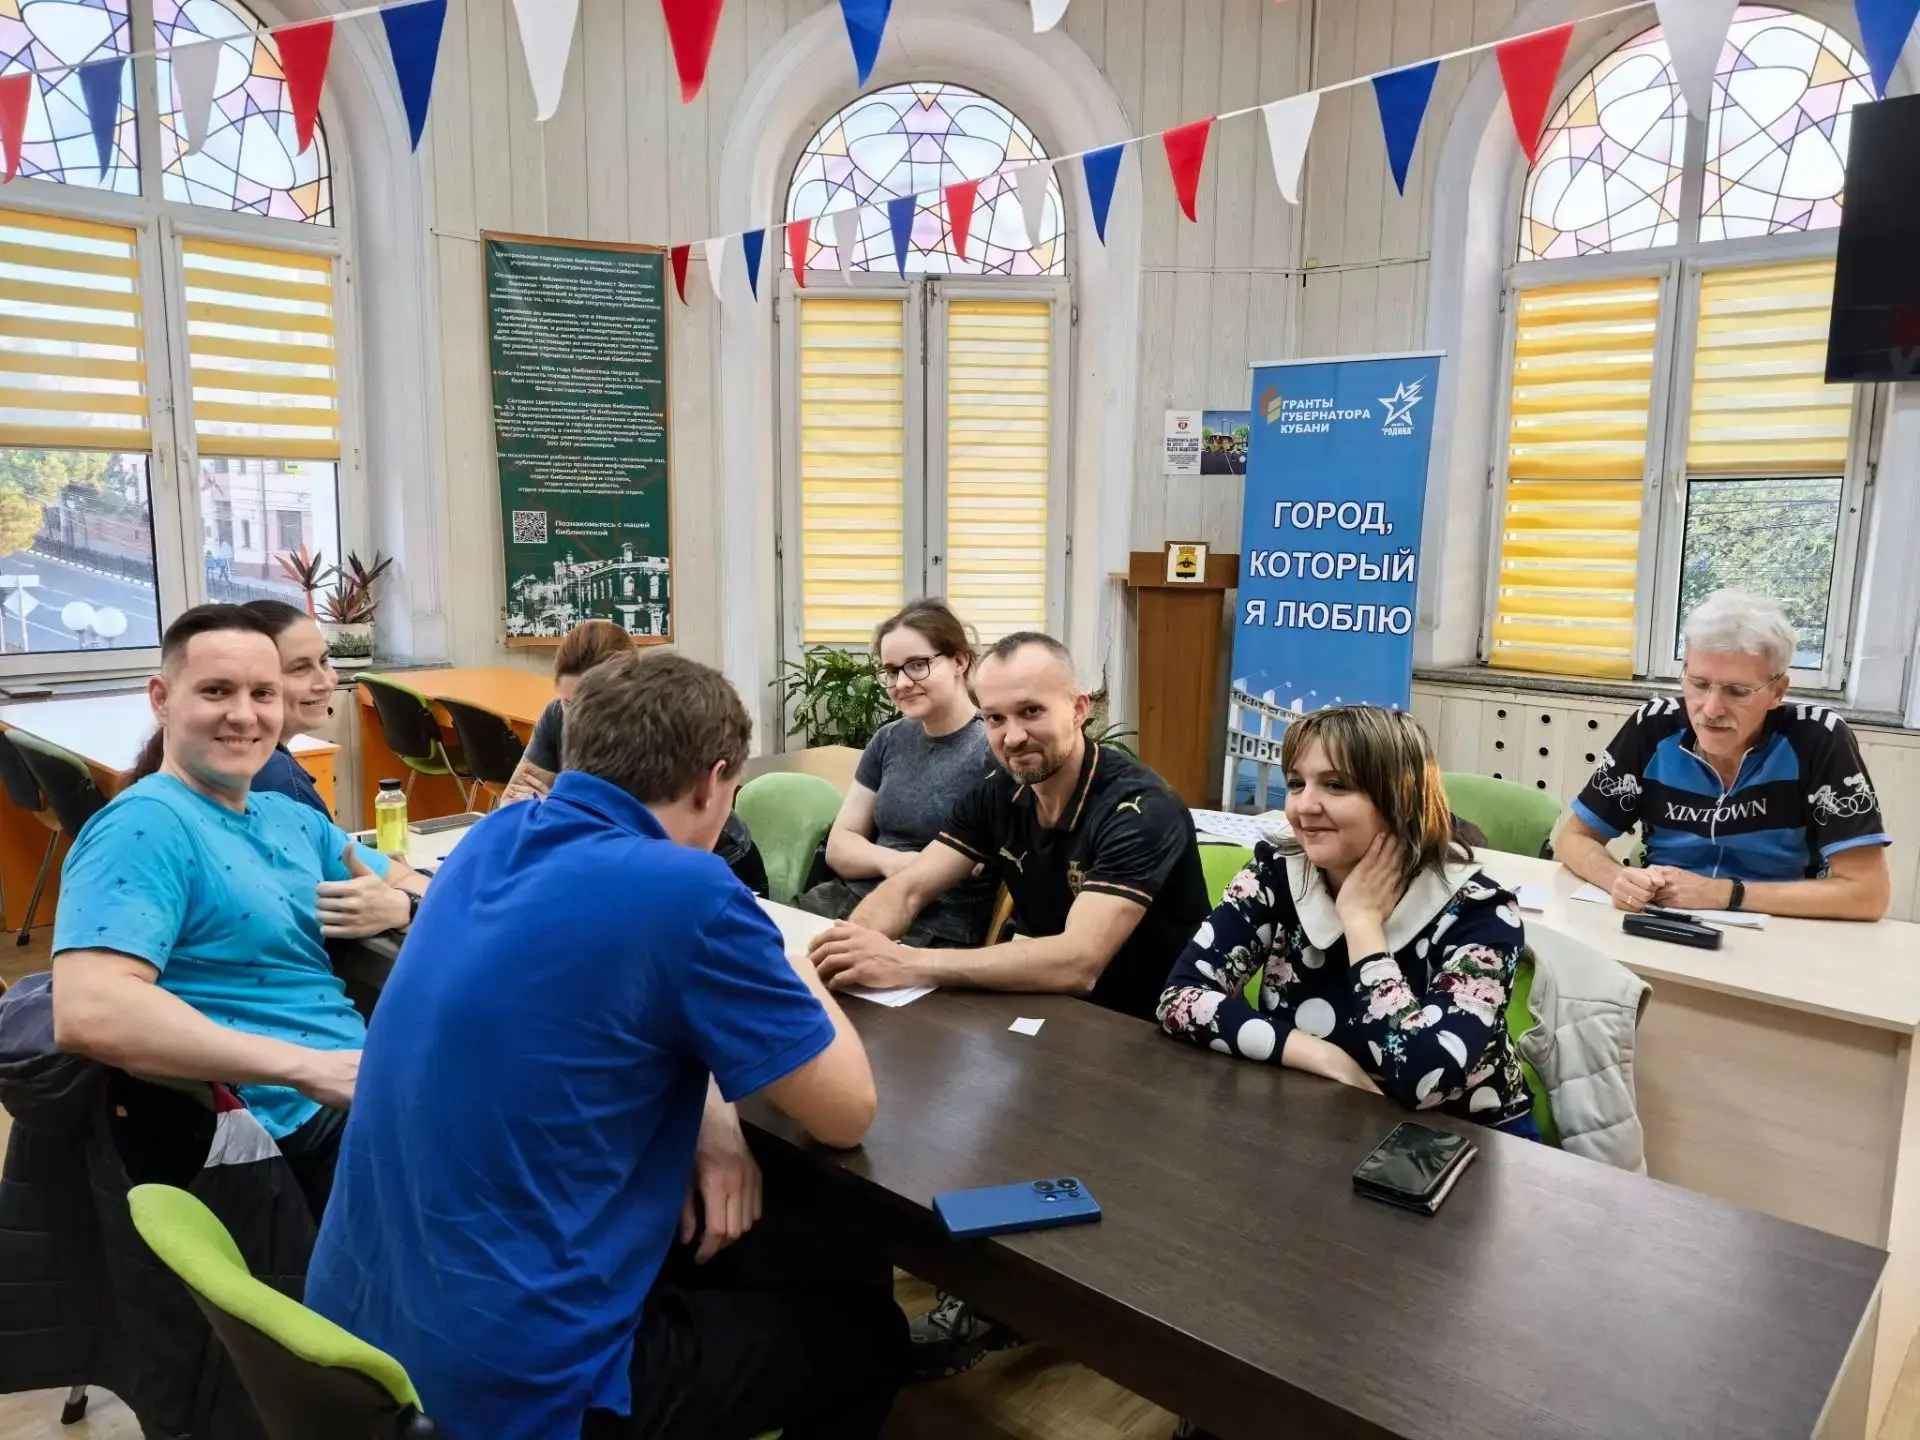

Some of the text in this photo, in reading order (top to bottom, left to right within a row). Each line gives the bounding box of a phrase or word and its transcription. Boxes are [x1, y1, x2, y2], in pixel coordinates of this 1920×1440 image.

[1282, 399, 1334, 410] ГРАНТЫ
[1281, 409, 1371, 422] ГУБЕРНАТОРА
[1280, 424, 1330, 434] КУБАНИ
[555, 520, 616, 529] Познакомьтесь
[1274, 502, 1393, 535] ГОРОД,
[1250, 548, 1415, 582] КОТОРЫЙ
[1244, 600, 1412, 635] Я ЛЮБЛЮ
[1664, 798, 1767, 823] XINTOWN
